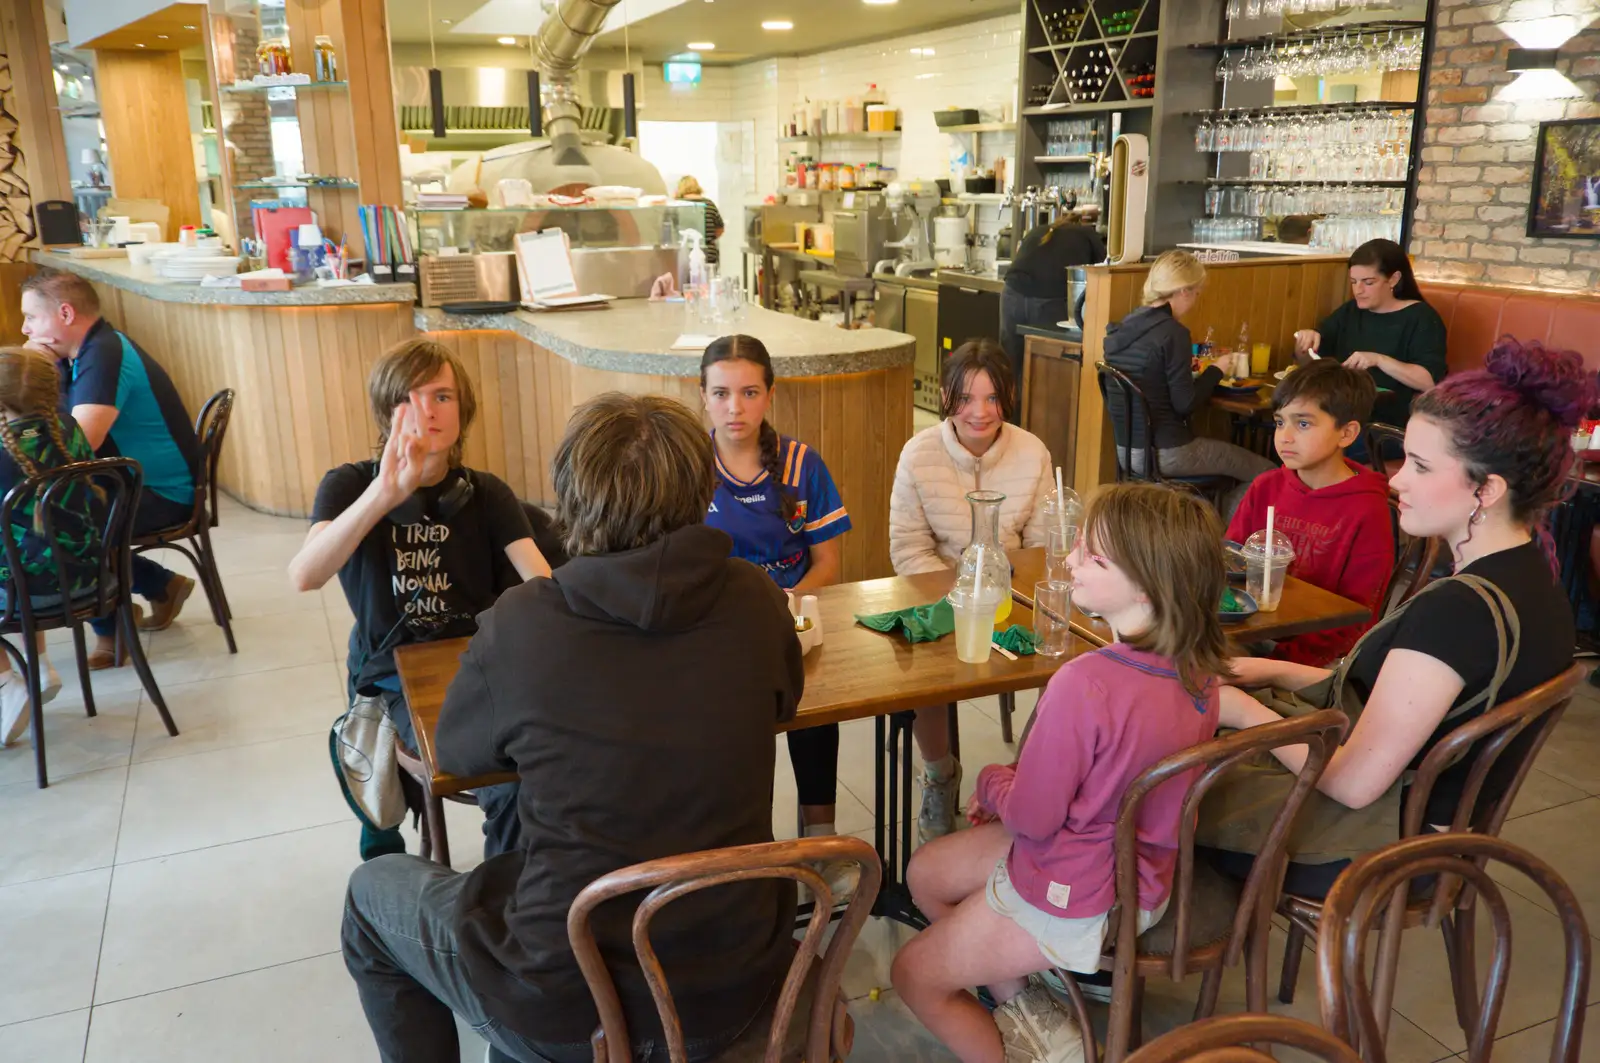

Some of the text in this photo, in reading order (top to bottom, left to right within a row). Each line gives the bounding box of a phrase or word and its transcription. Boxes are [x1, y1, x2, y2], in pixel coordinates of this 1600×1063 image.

[392, 522, 450, 544] I TRIED
[1275, 515, 1330, 538] CHICAGO
[395, 548, 441, 571] BEING
